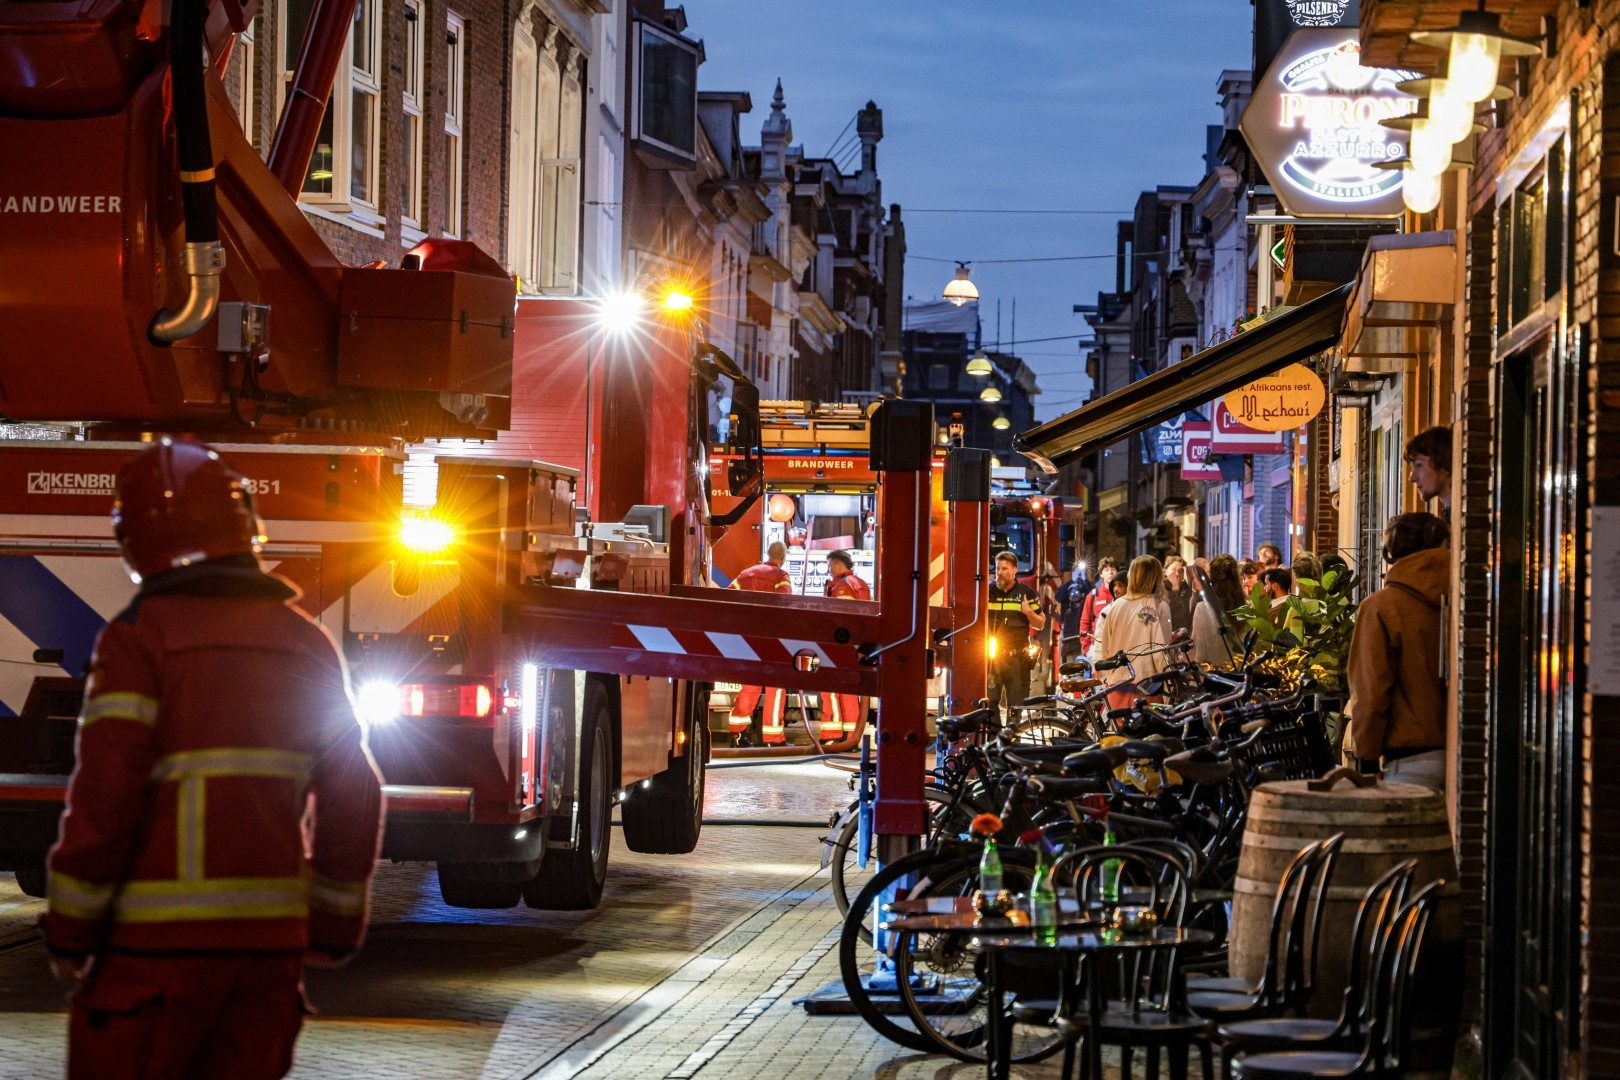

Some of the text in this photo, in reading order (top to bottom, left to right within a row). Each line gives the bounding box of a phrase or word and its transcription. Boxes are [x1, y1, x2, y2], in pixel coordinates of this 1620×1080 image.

[1296, 1, 1339, 16] PILSENER
[1293, 141, 1403, 158] AZZURRO
[1312, 182, 1382, 198] ITALIANA
[0, 196, 121, 213] ANDWEER
[1249, 384, 1292, 392] Afrikaans
[1294, 383, 1313, 391] rest.
[788, 460, 854, 469] BRANDWEER
[51, 473, 116, 489] KENBRI
